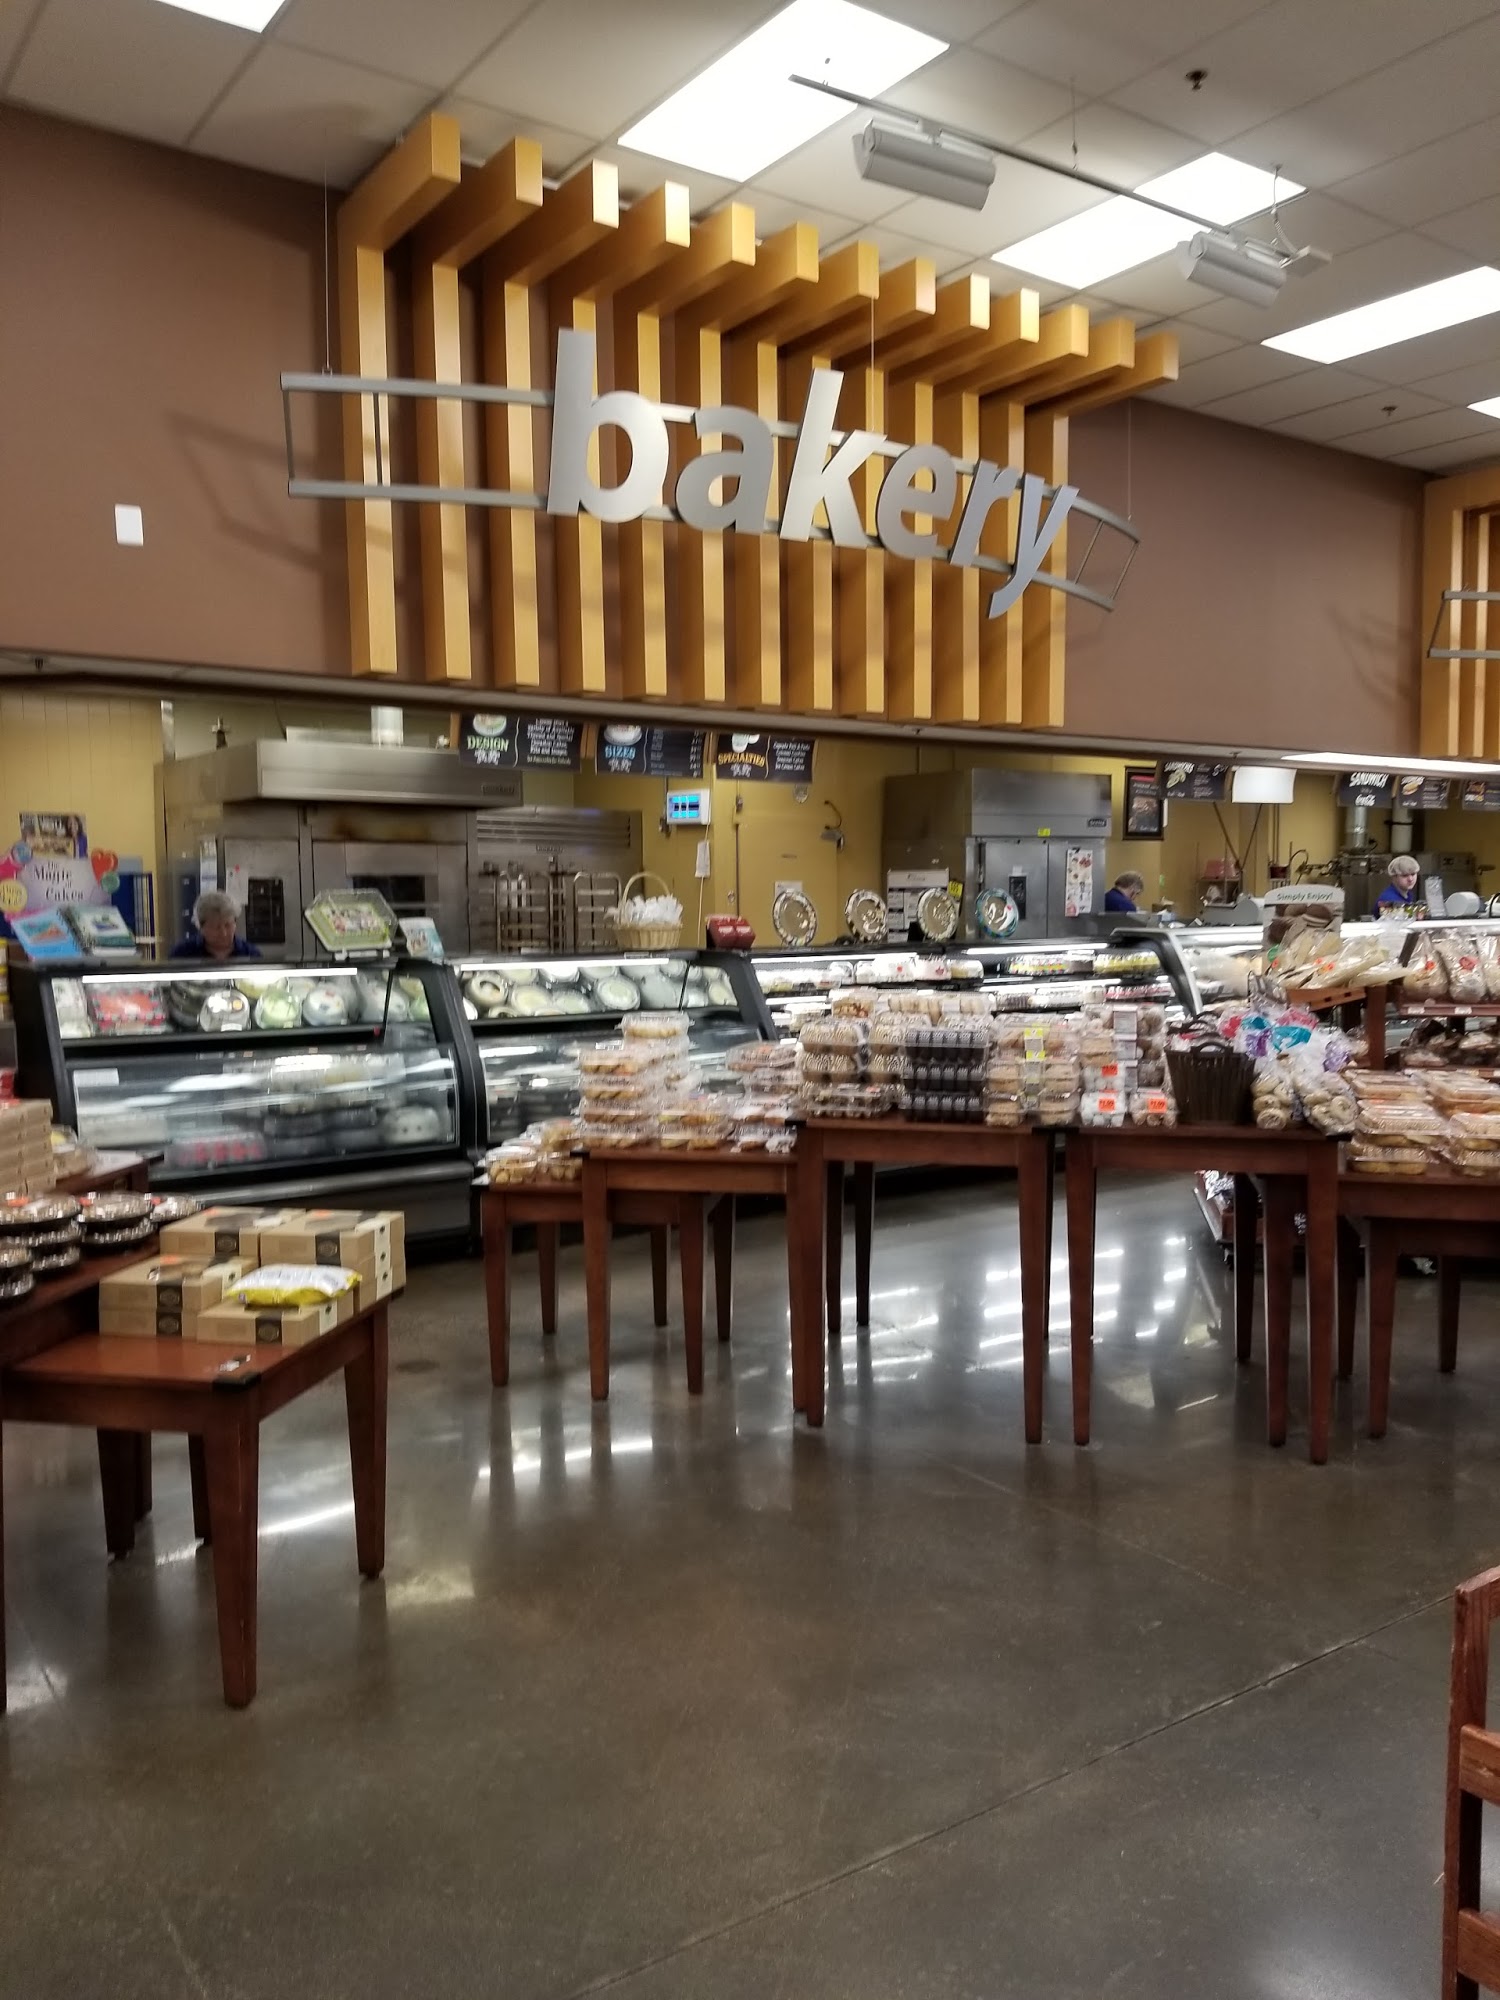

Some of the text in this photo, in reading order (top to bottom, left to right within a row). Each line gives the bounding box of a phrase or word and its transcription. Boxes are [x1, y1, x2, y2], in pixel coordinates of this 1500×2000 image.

[547, 328, 1080, 619] bakery
[467, 735, 509, 752] DESIGN
[605, 745, 636, 760] SIZES
[718, 752, 766, 768] SPECIALTIES
[1350, 772, 1390, 788] SANDWICH
[34, 867, 71, 885] Magic
[45, 888, 84, 901] Cakes
[1277, 892, 1334, 902] Simply Enjoy!
